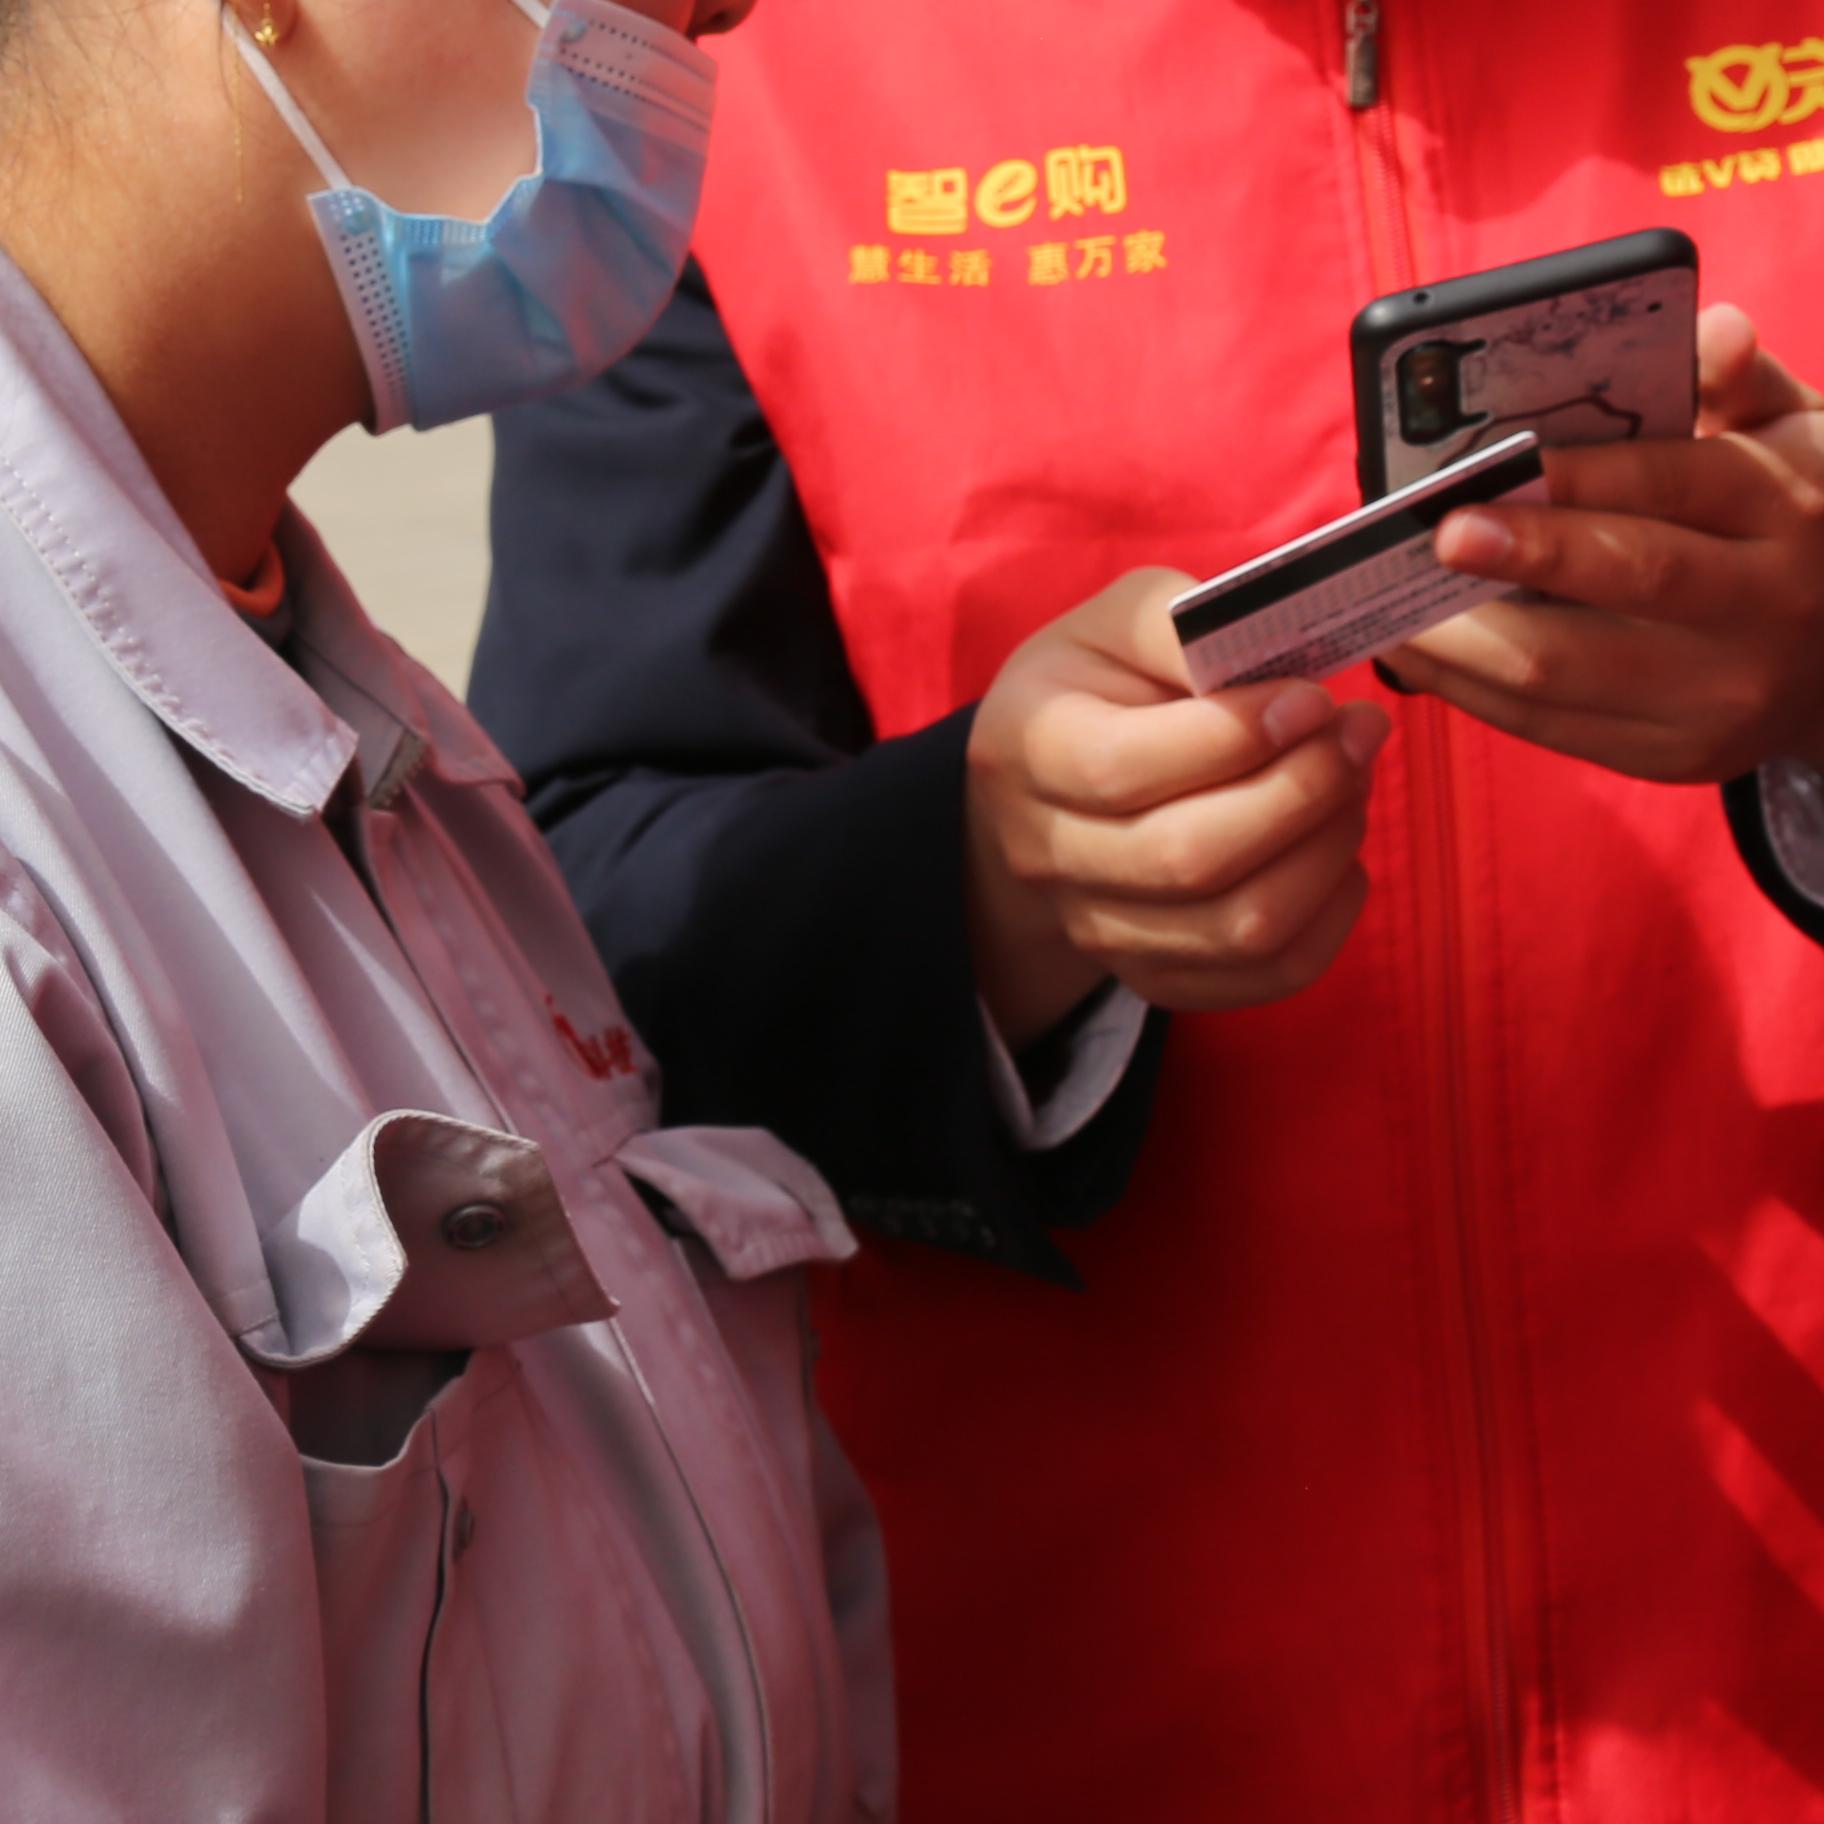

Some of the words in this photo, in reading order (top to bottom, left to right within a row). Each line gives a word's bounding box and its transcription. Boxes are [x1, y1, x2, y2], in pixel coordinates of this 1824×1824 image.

[886, 143, 1127, 236] 智e购
[1026, 229, 1167, 286] 惠万家
